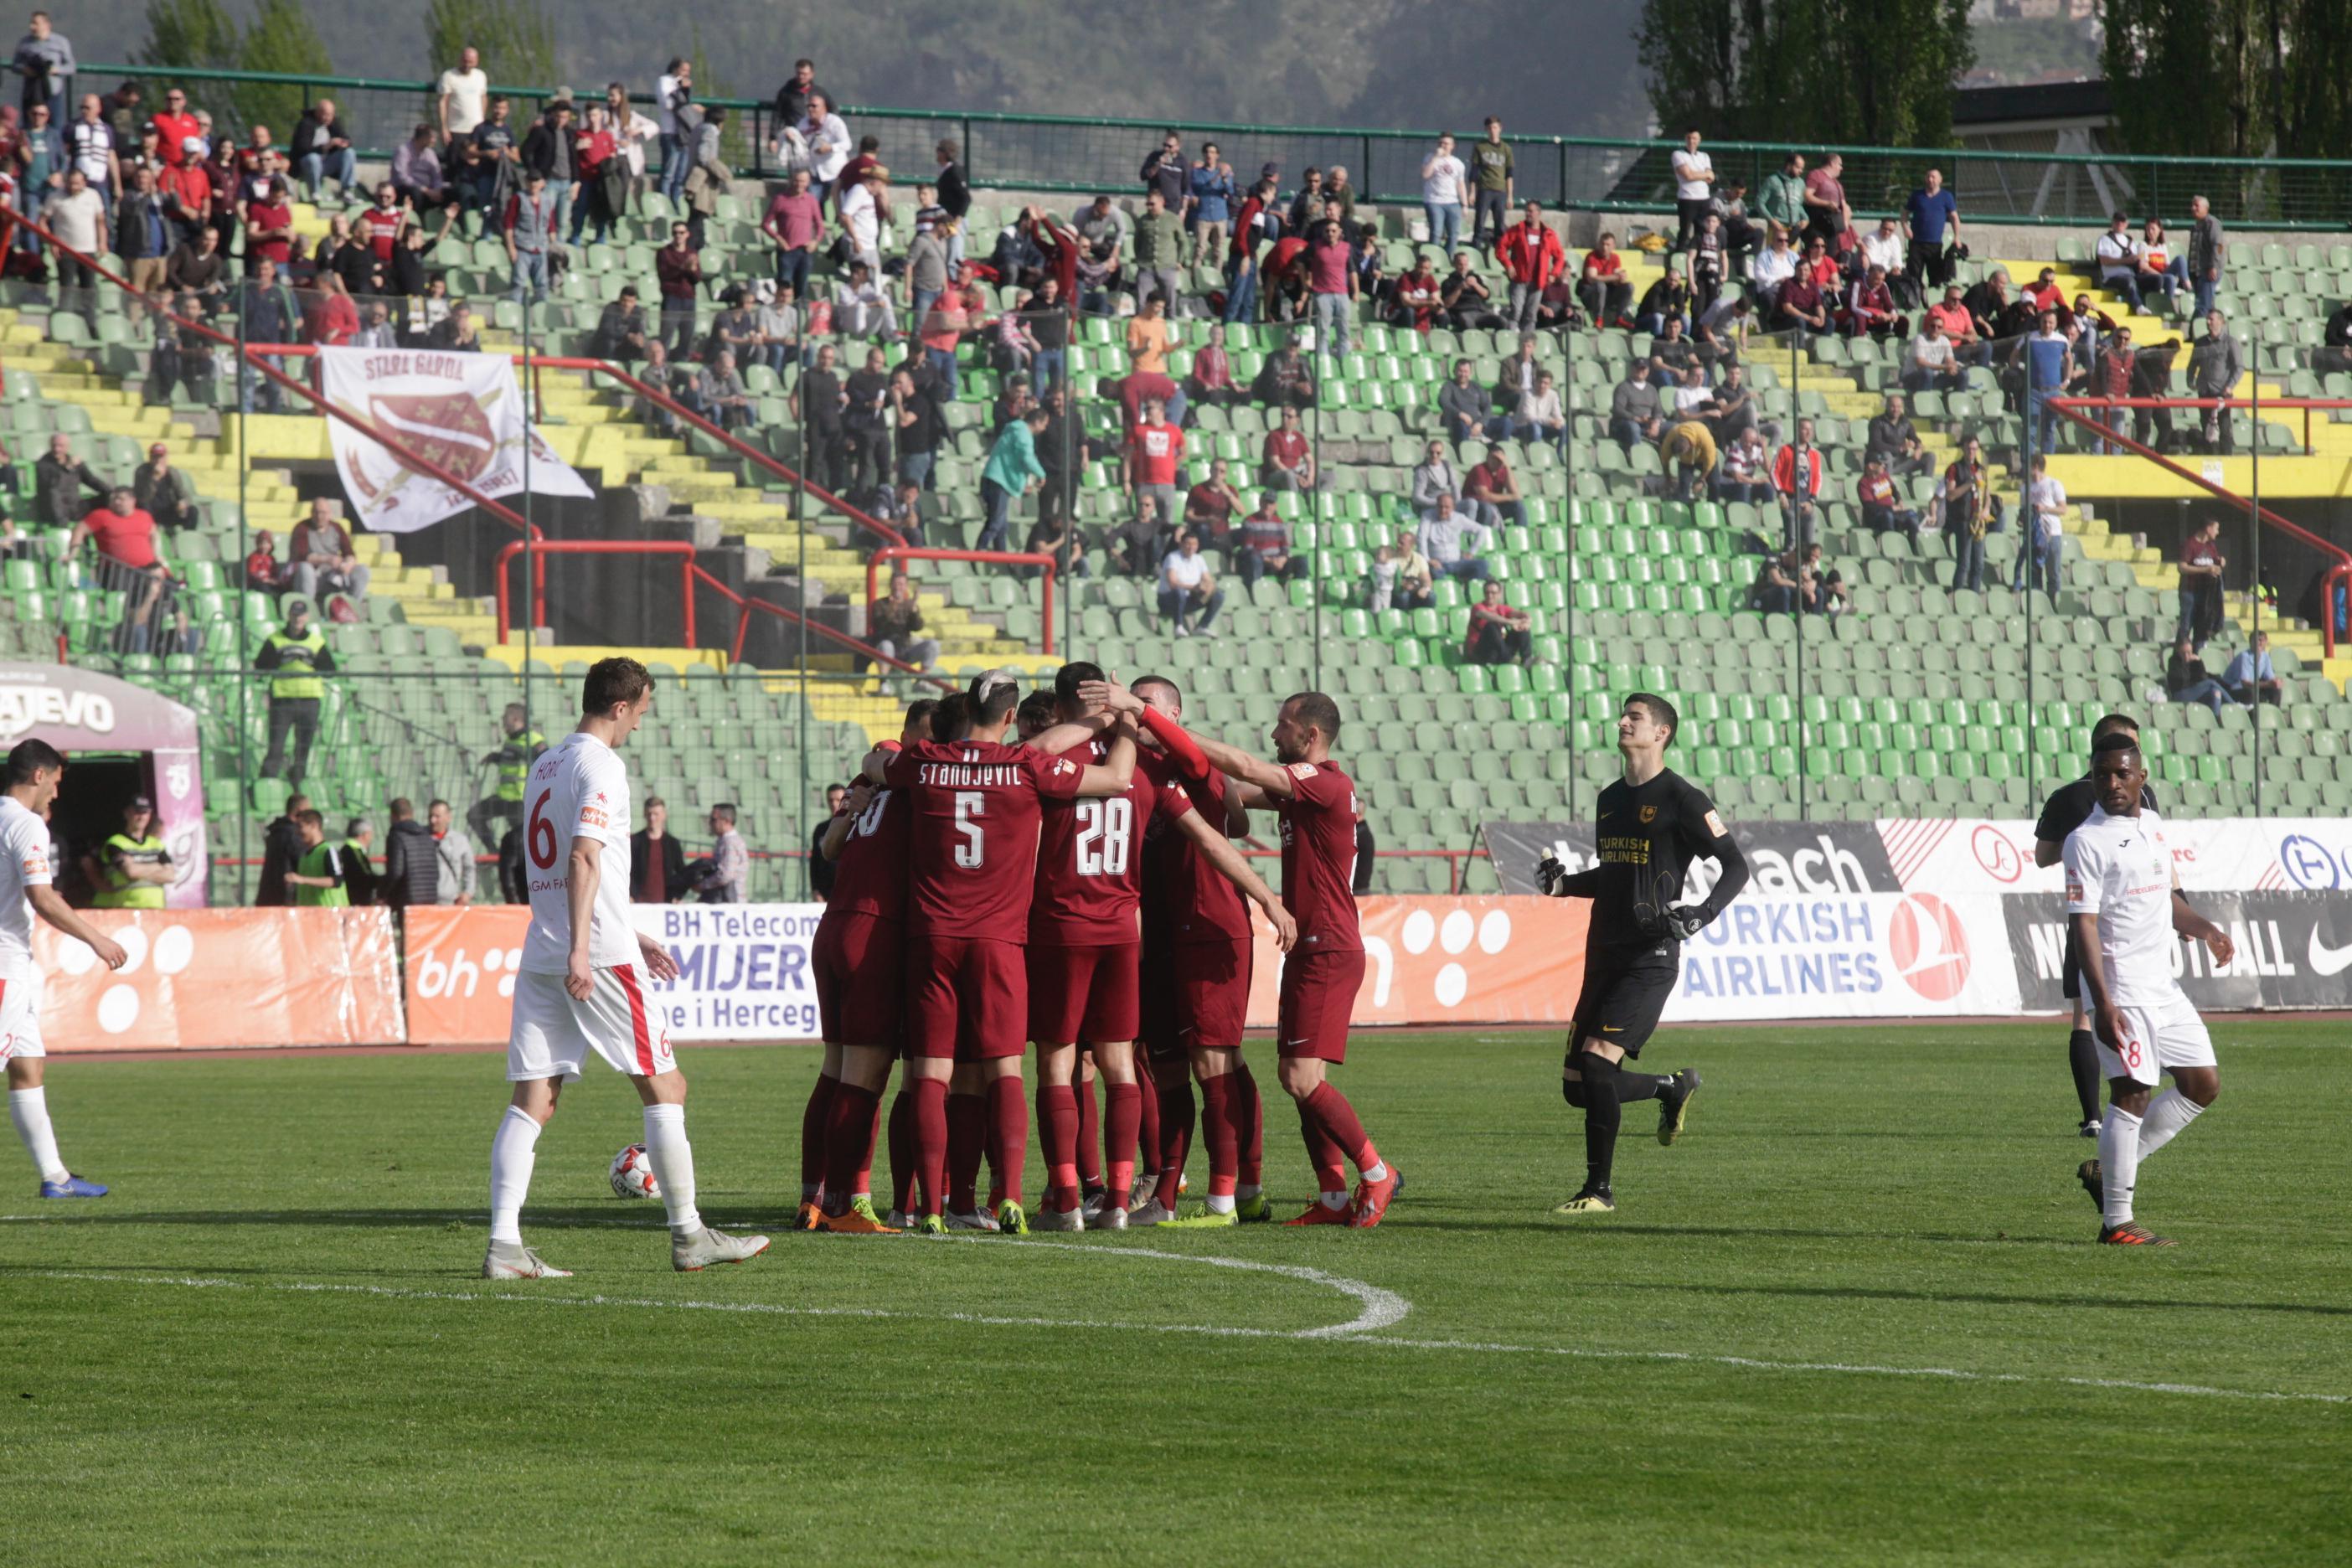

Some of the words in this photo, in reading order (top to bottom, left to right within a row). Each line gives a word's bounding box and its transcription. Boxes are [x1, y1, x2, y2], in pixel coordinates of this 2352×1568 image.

[528, 787, 557, 869] 6
[845, 790, 893, 842] 0
[955, 792, 984, 869] 5
[1075, 797, 1132, 876] 28
[1599, 838, 1650, 852] TURKISH
[1600, 850, 1648, 865] AIRLINES
[665, 910, 700, 937] BH
[1685, 902, 1874, 946] URKISH
[1682, 952, 1884, 998] AIRLINES
[696, 998, 703, 1028] i
[714, 998, 817, 1033] Herceg
[660, 1029, 671, 1058] 6
[2128, 1040, 2142, 1069] 8
